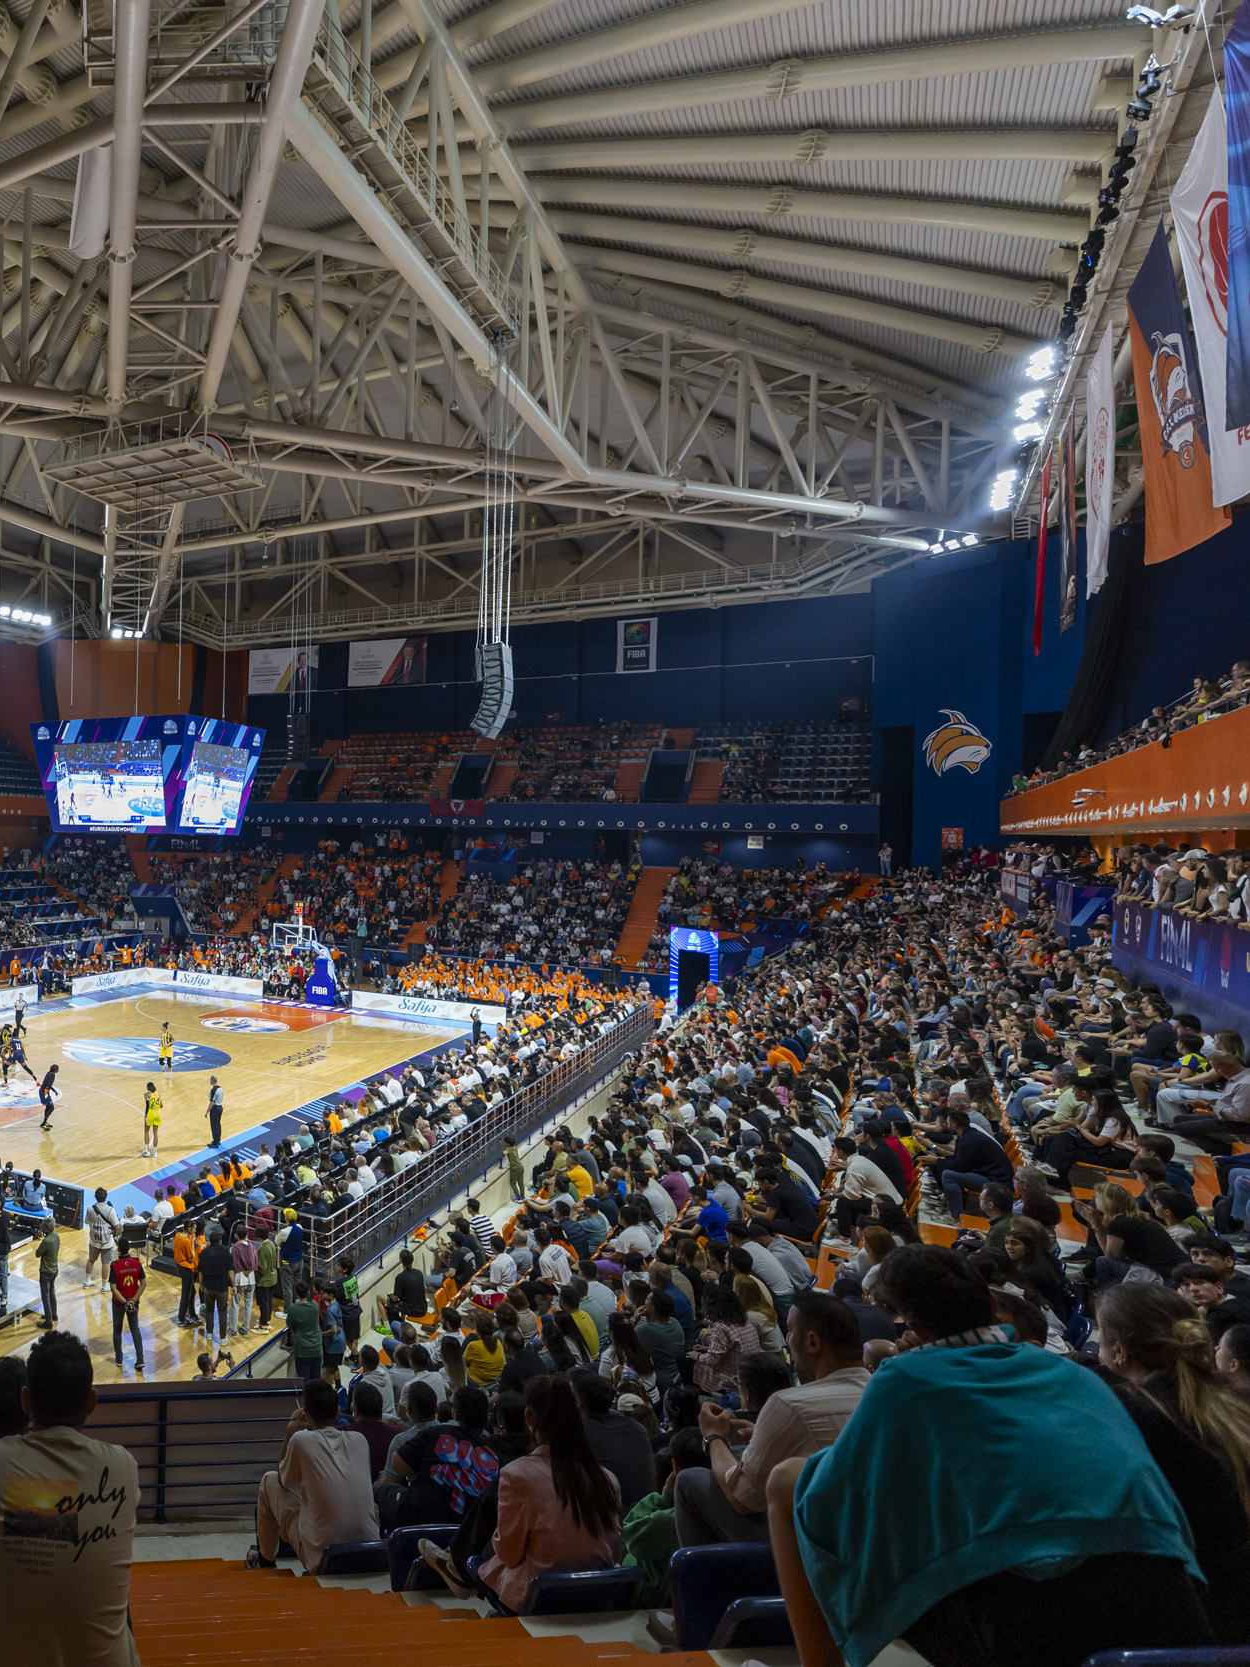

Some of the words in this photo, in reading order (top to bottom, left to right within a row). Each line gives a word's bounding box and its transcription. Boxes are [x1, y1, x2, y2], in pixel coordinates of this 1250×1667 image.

[627, 650, 646, 659] FIBA
[96, 974, 117, 988] Safiya
[179, 972, 211, 987] Safiya
[312, 986, 328, 996] FIBA
[398, 998, 437, 1014] Safiya
[151, 1097, 160, 1107] 24
[54, 1466, 127, 1519] only
[71, 1523, 118, 1563] you
